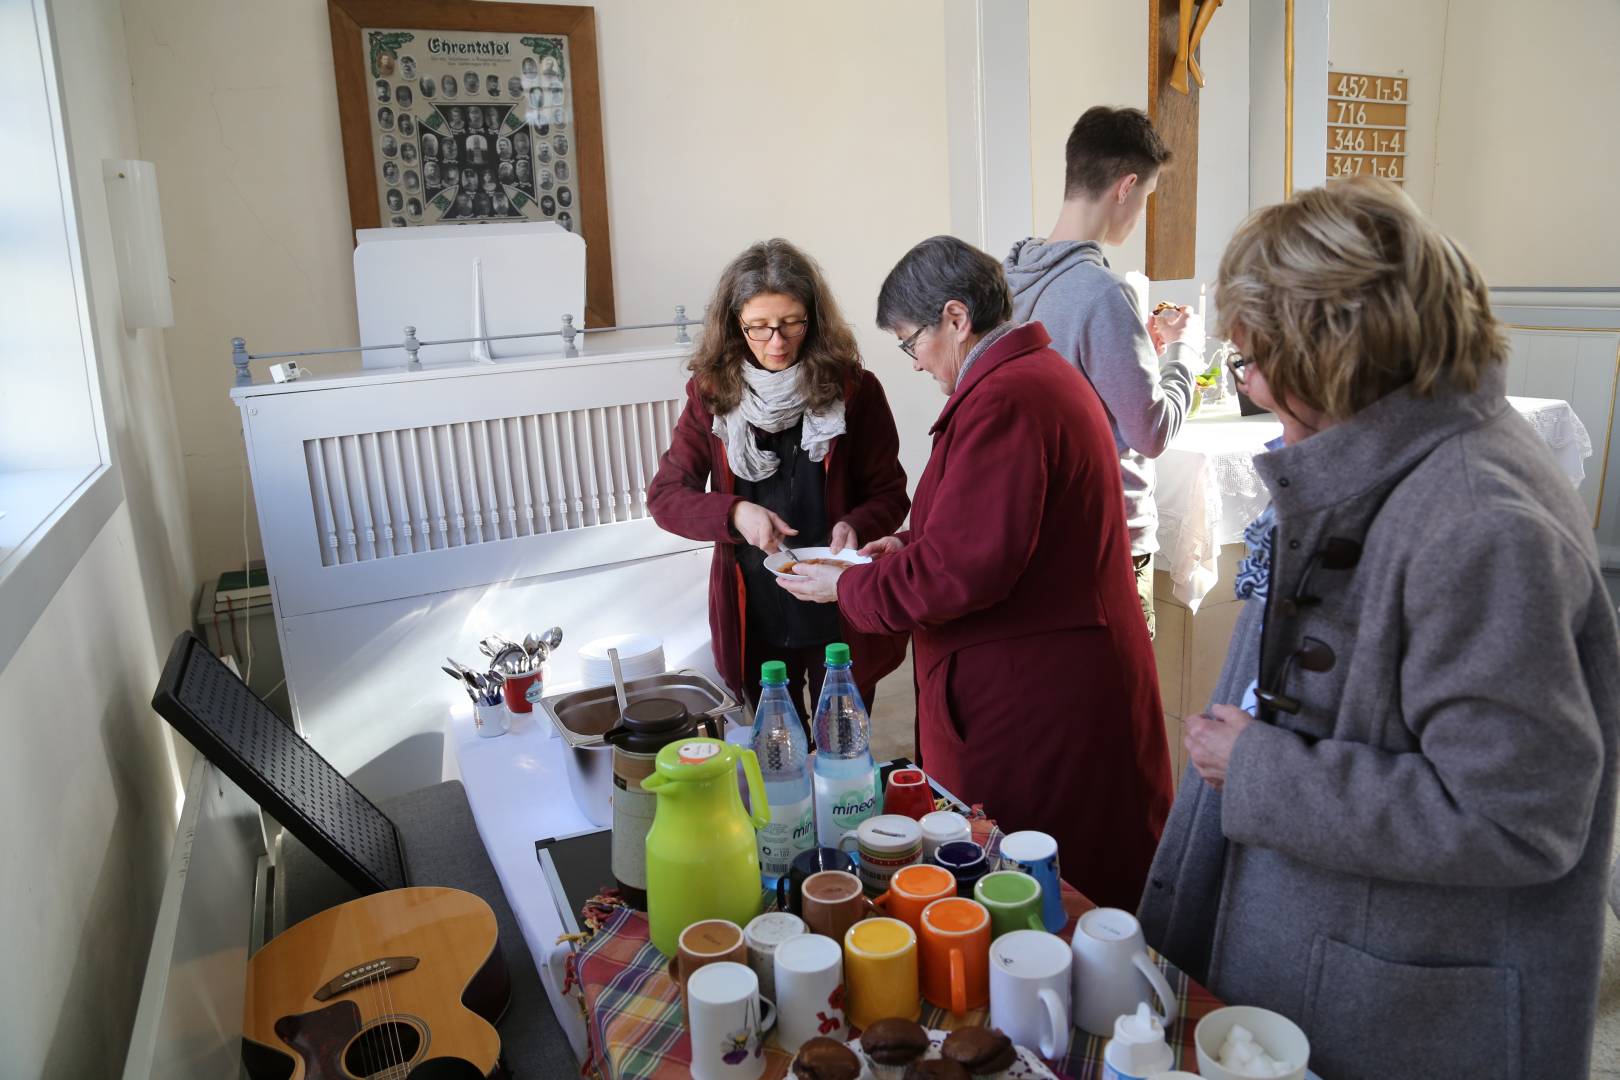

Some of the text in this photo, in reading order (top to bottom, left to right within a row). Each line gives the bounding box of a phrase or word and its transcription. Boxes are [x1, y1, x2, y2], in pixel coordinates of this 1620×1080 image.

[1337, 75, 1368, 98] 452
[1337, 102, 1367, 125] 716
[1334, 129, 1365, 151] 346
[1332, 156, 1363, 177] 347
